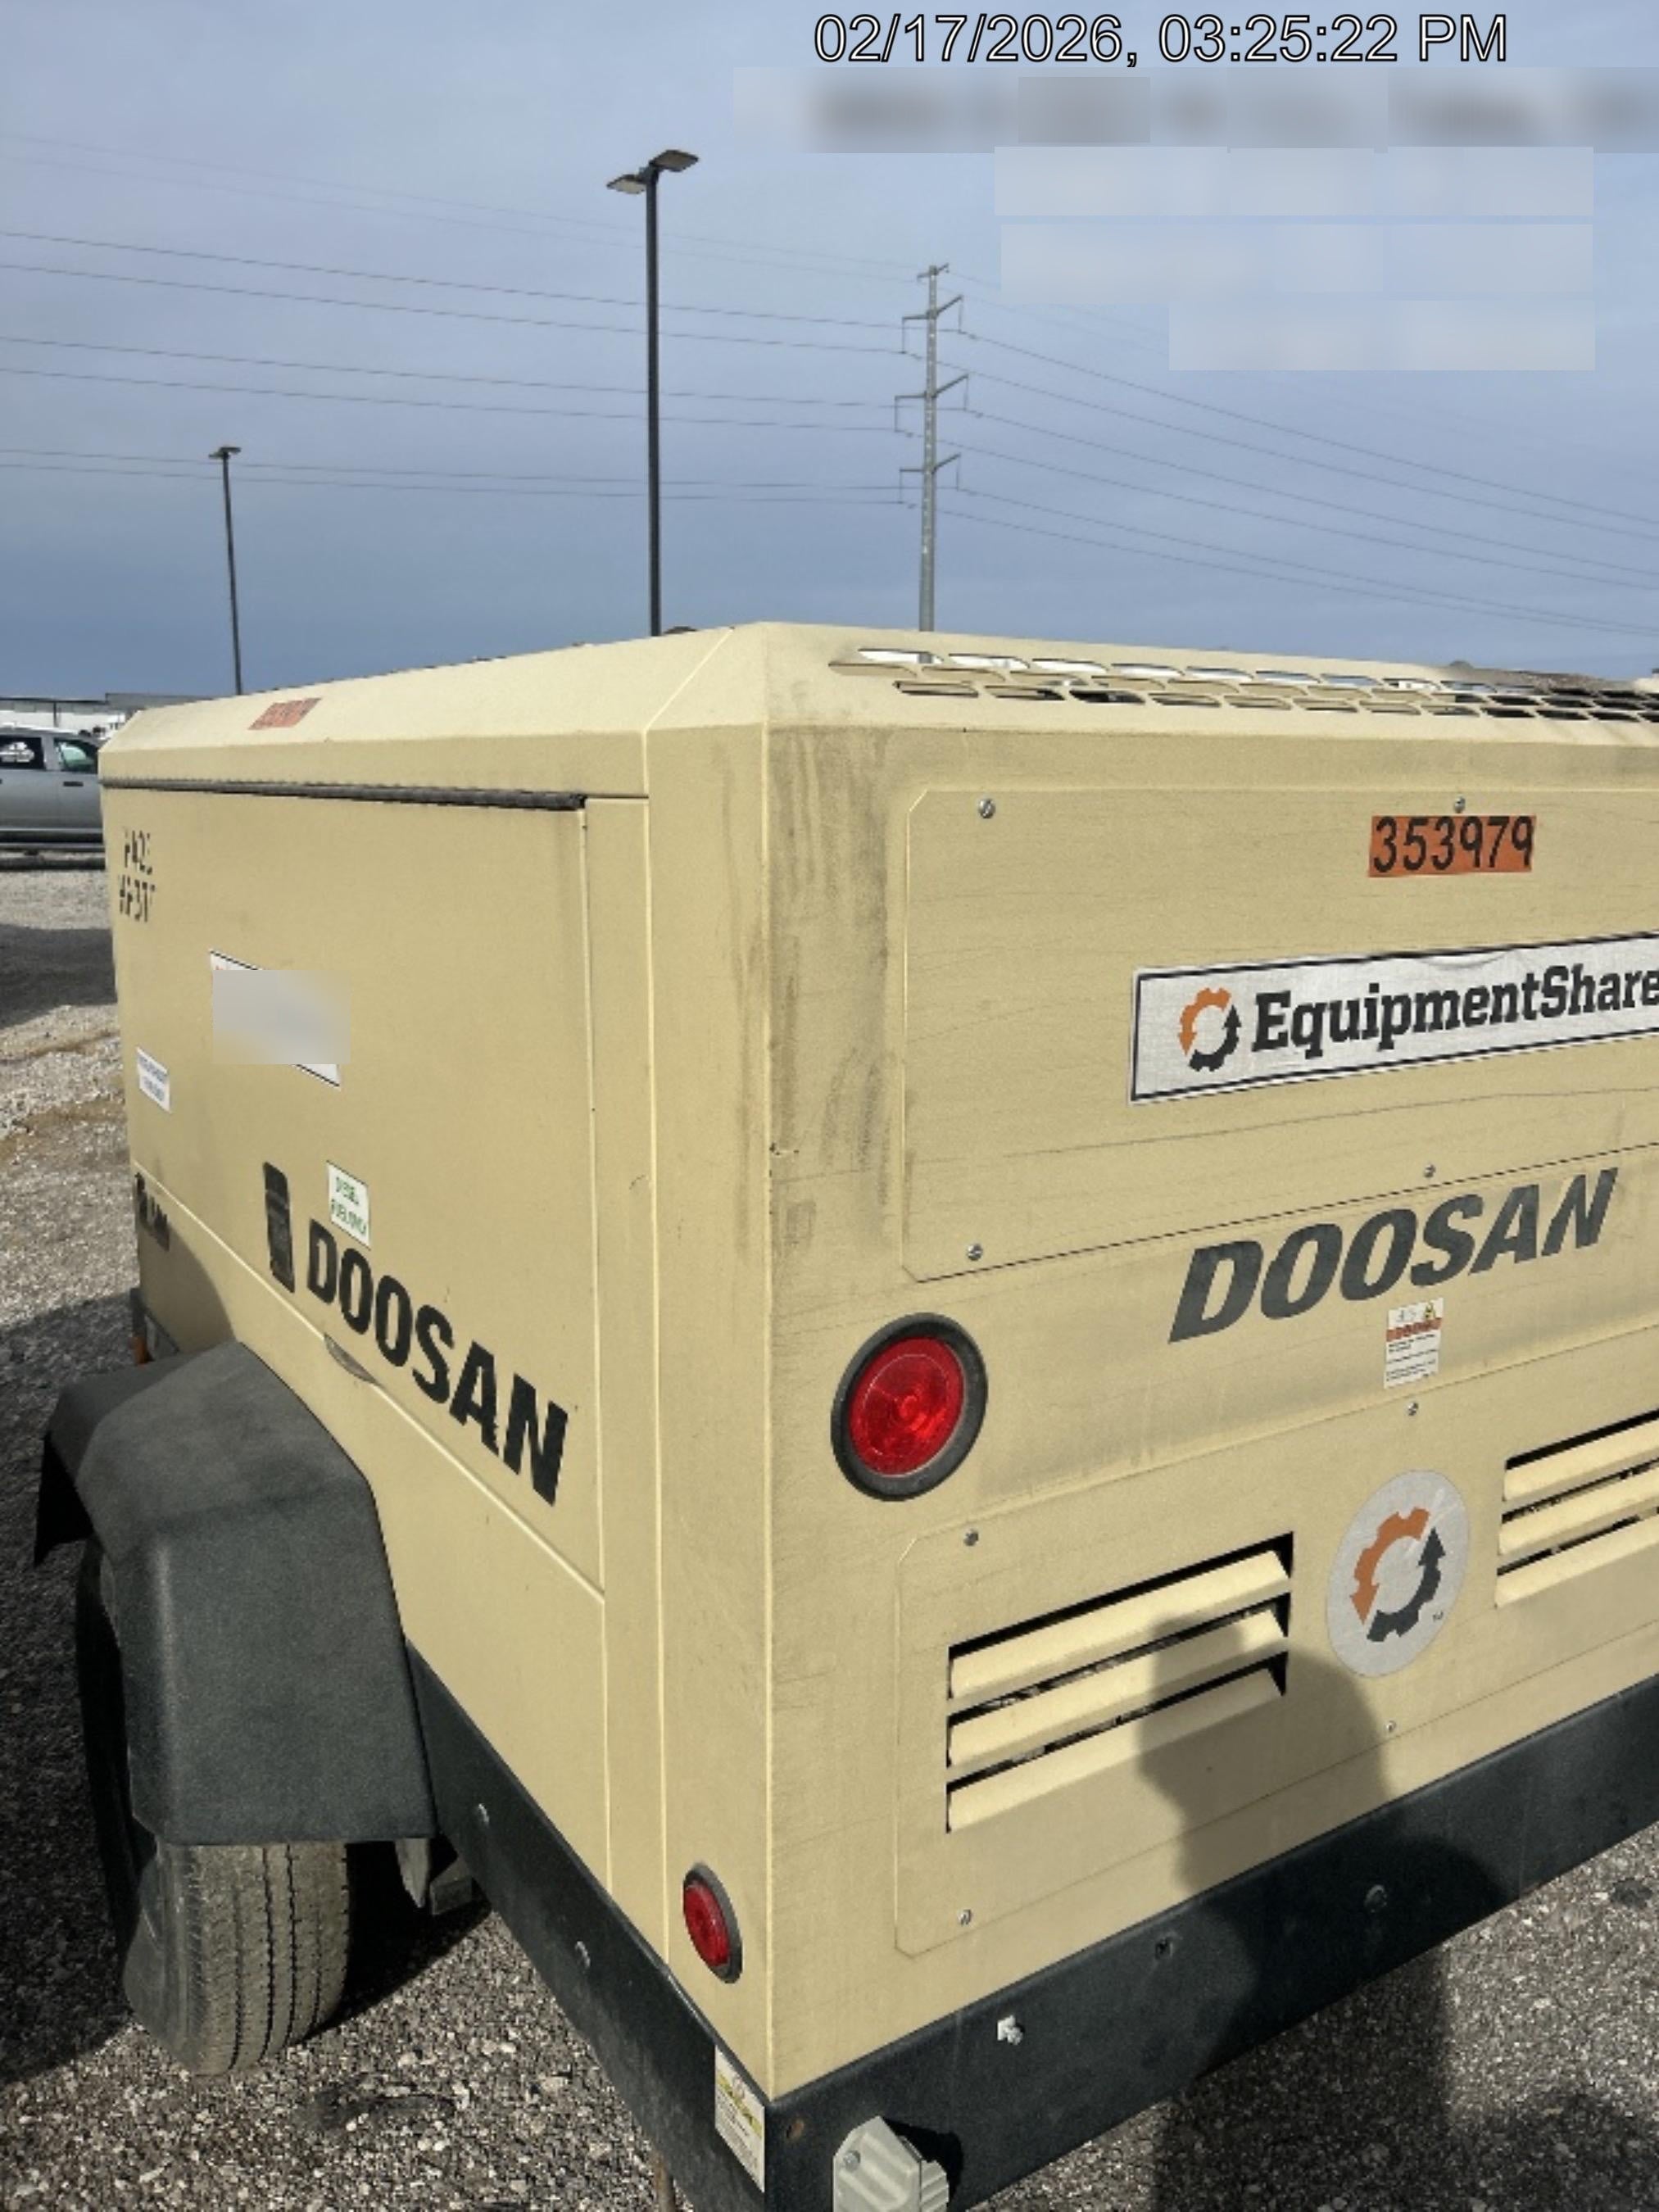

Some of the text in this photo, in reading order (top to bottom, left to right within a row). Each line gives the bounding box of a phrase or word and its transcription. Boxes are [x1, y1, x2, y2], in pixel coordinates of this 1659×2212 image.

[1373, 815, 1534, 873] 353979
[1251, 963, 1659, 1059] EquipmentShare
[1168, 1167, 1619, 1344] DOOSAN
[307, 1217, 569, 1507] DOOSAN
